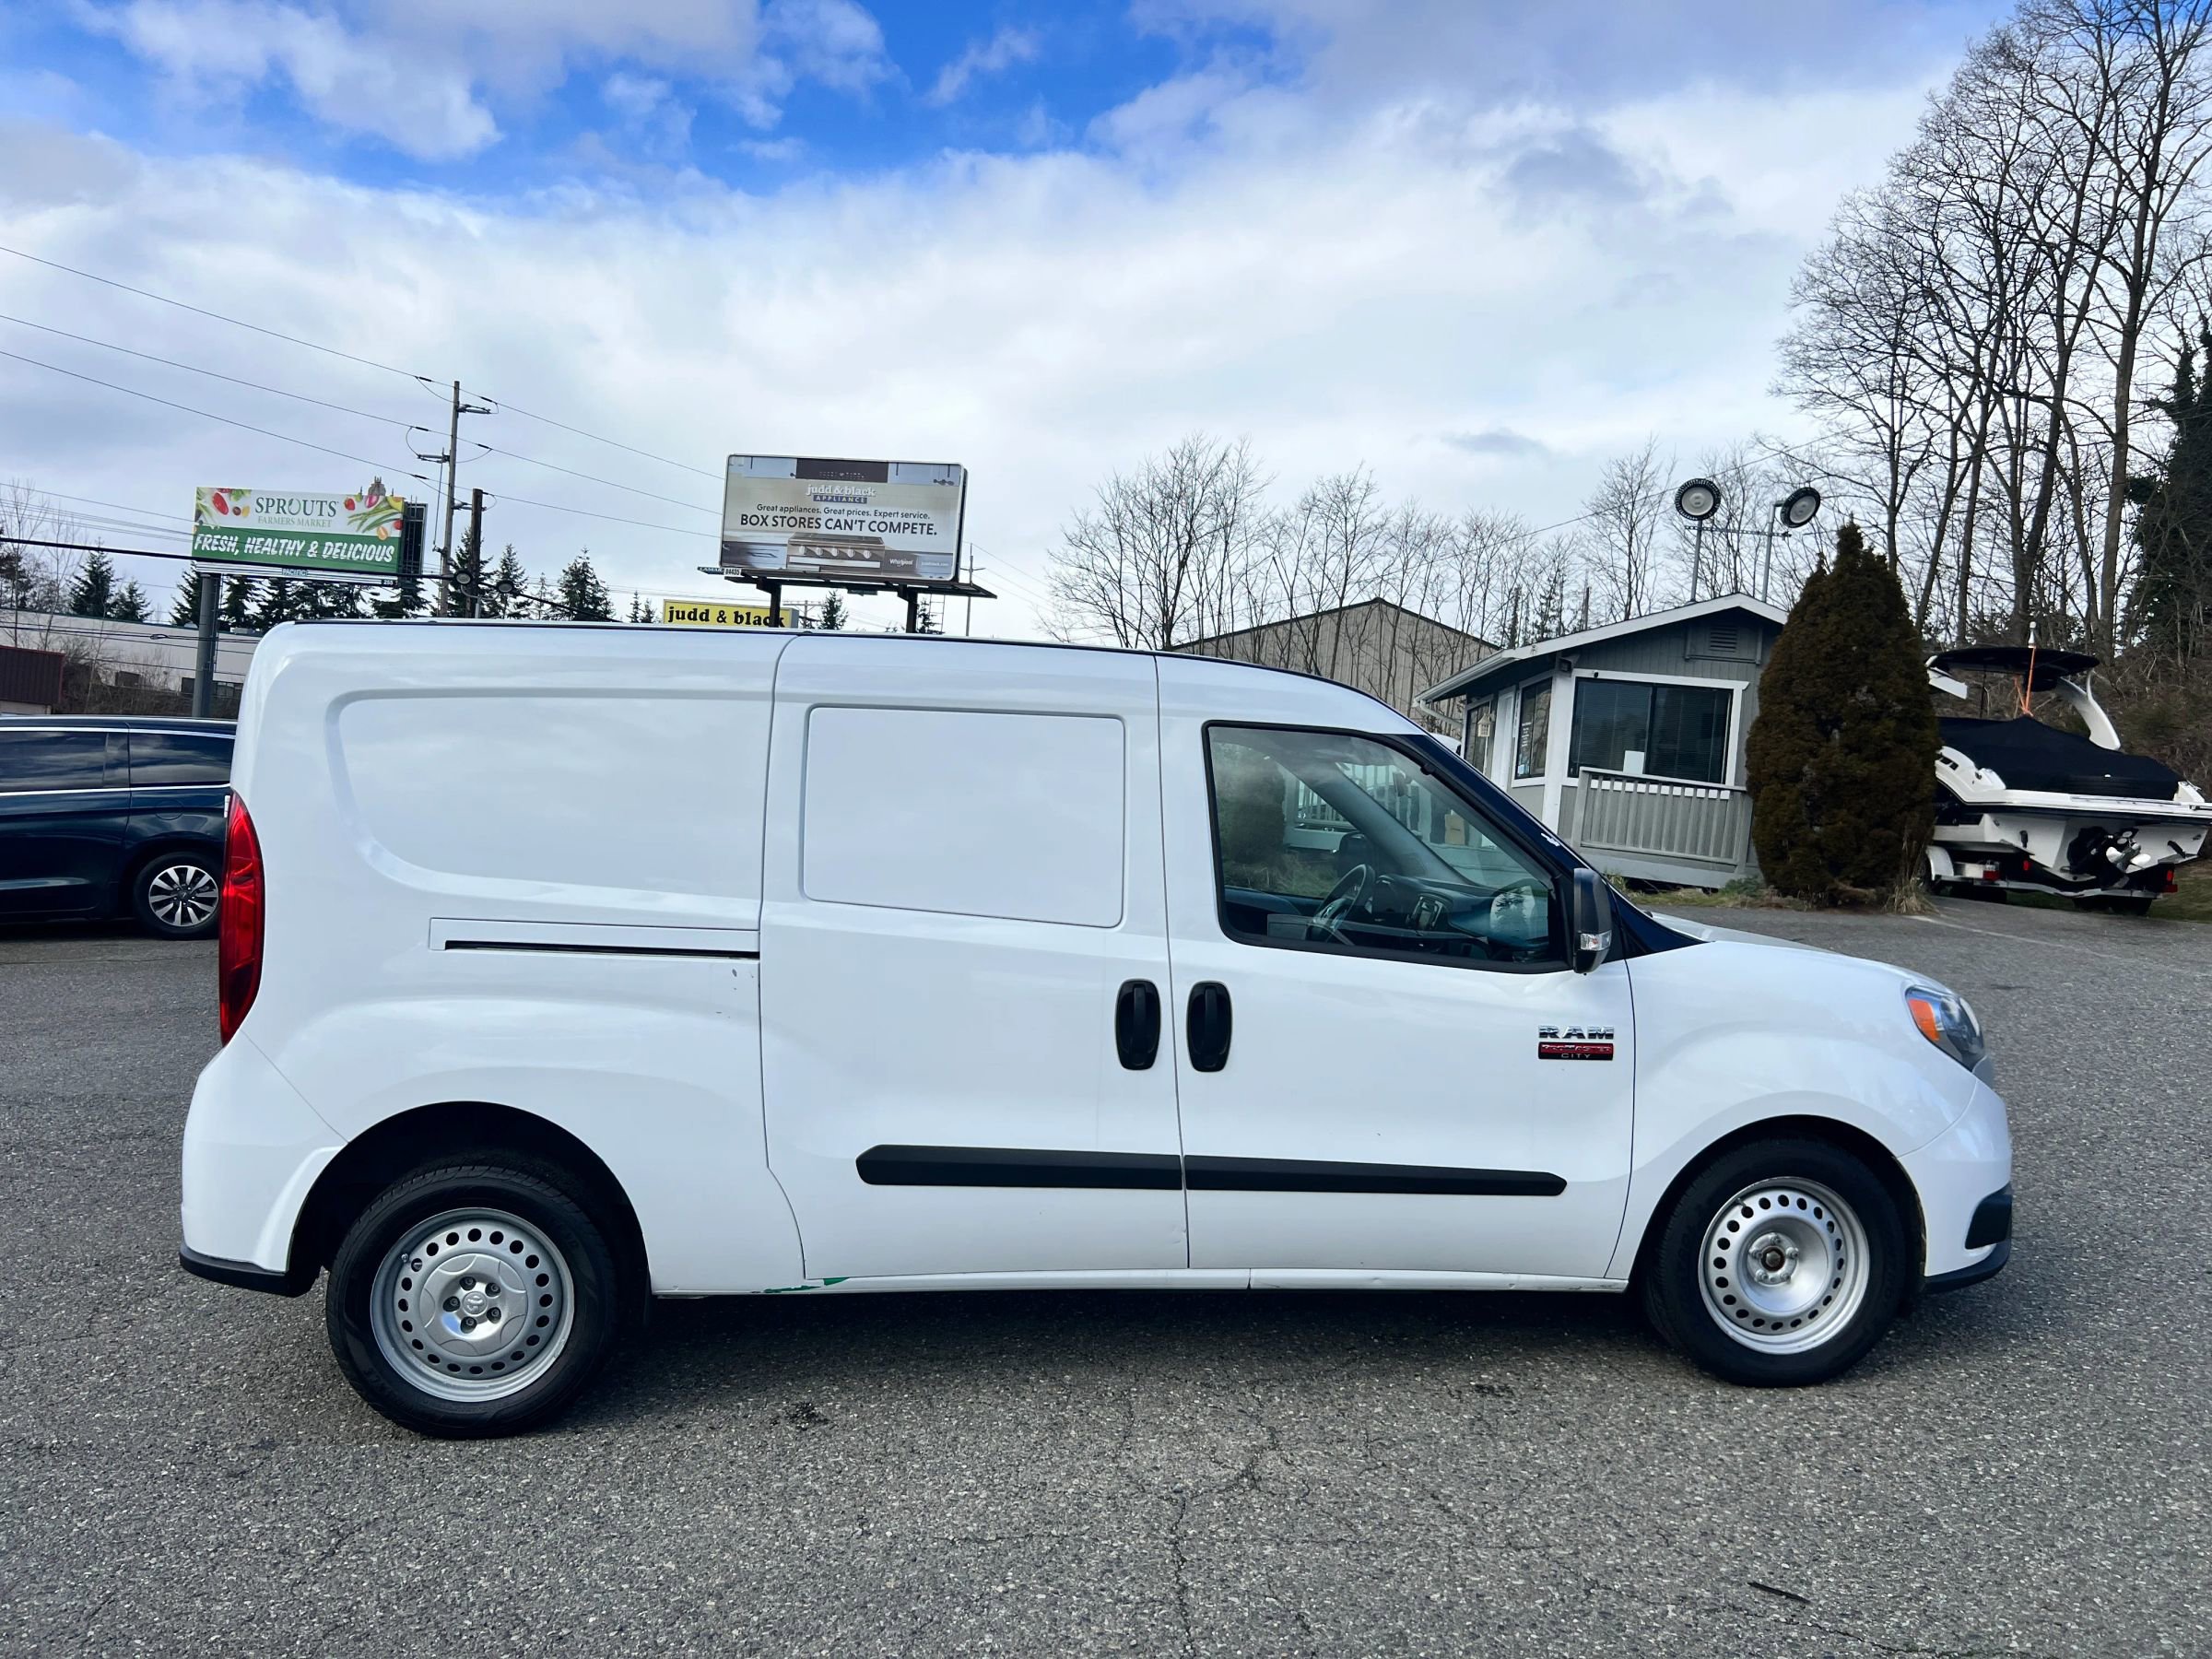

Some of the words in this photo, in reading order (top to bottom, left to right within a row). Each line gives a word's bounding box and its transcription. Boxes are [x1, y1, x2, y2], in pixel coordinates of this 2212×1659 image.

[806, 484, 831, 496] judd
[844, 486, 877, 497] black
[816, 495, 865, 503] APPLIANCE
[254, 497, 337, 518] SPROUTS
[757, 504, 778, 512] Great
[779, 505, 822, 514] appliances.
[823, 507, 845, 515] Great
[846, 509, 872, 517] prices.
[874, 510, 900, 519] Expert
[900, 512, 931, 520] service.
[257, 516, 295, 526] FARMERS
[297, 518, 333, 528] MARKET
[740, 513, 770, 527] BOX
[771, 515, 822, 530] STORES
[824, 518, 866, 532] CAN'T
[868, 520, 937, 535] COMPETE.
[194, 533, 240, 555] FRESH,
[244, 536, 306, 557] HEALTHY
[307, 541, 319, 558] &
[322, 541, 395, 563] DELICIOUS
[668, 606, 710, 623] judd
[716, 609, 727, 624] &
[1538, 1025, 1614, 1040] RAM
